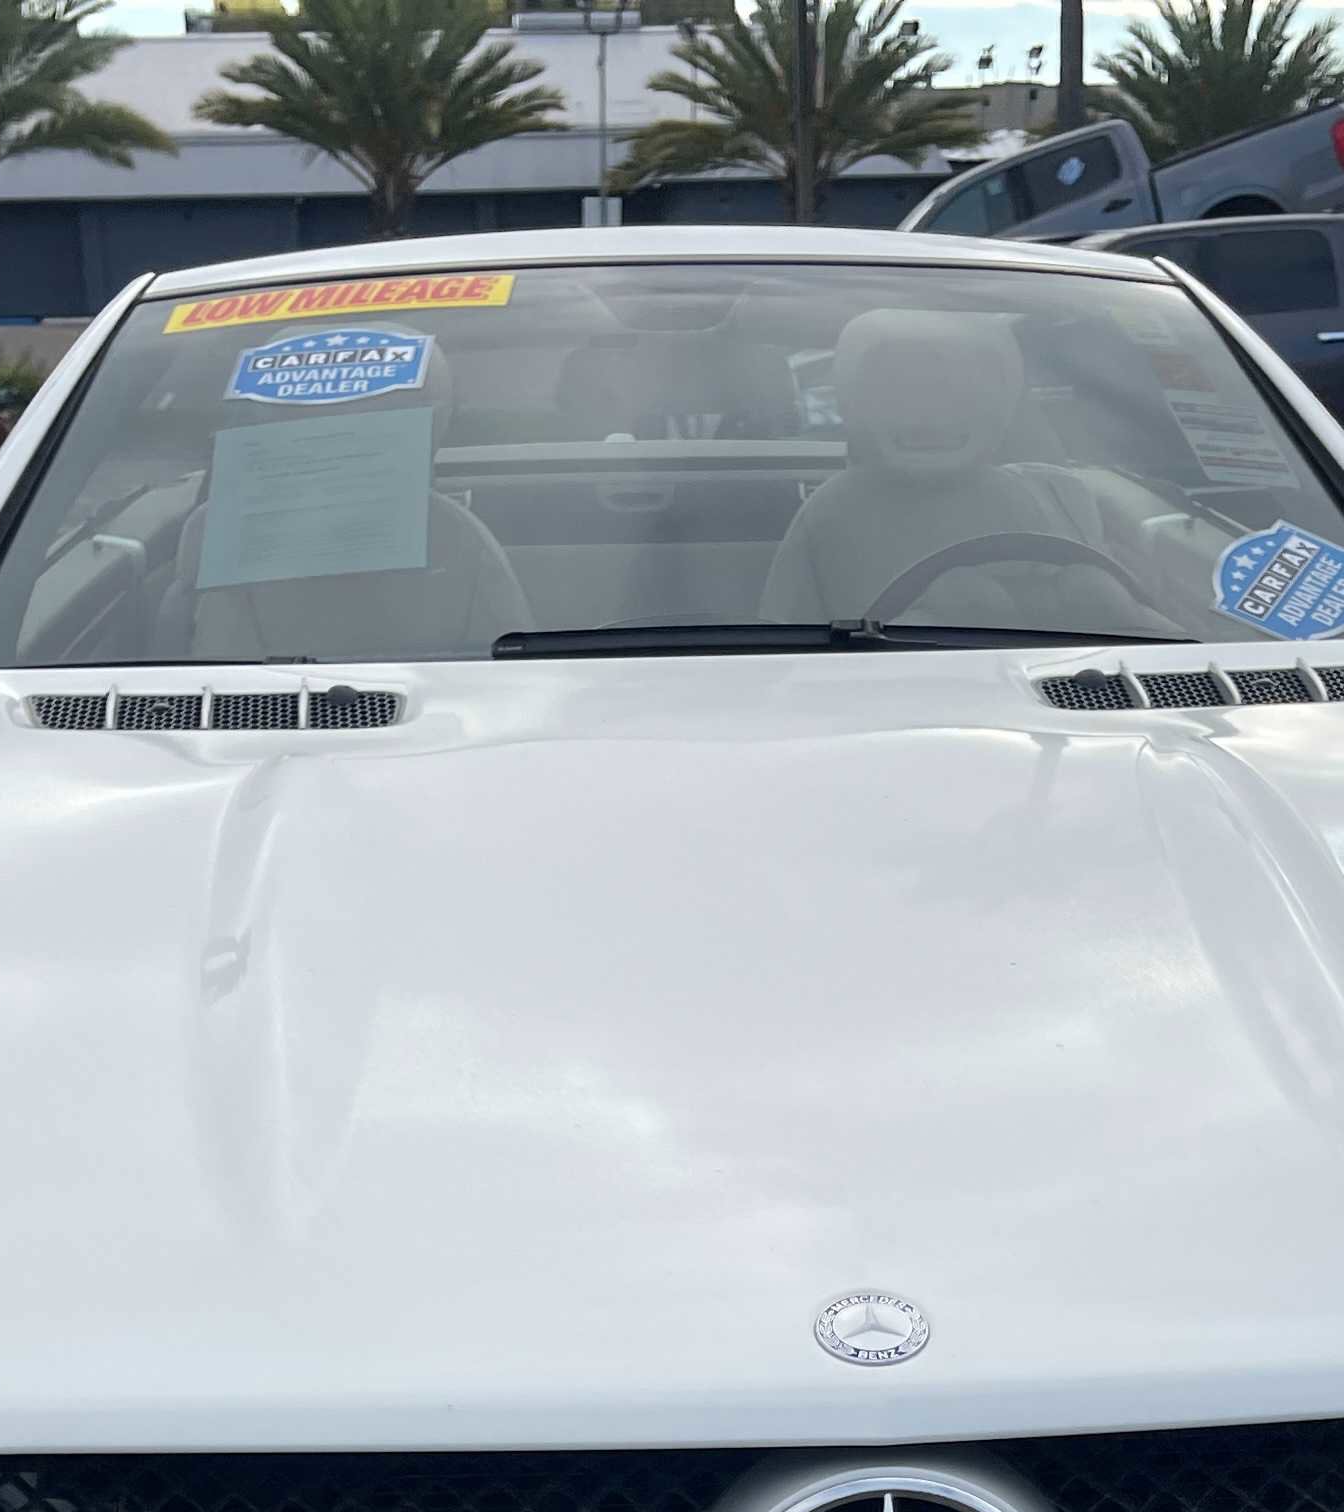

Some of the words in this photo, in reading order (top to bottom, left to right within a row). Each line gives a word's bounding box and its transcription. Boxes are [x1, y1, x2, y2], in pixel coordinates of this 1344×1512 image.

[181, 290, 290, 326] LOW
[287, 276, 495, 313] MILEAGE
[253, 346, 414, 371] CARFAX
[257, 364, 397, 386] ADVANTAGE
[277, 379, 369, 398] DEALER
[1238, 538, 1319, 618] CARFAX
[1277, 553, 1344, 627] ADVANTAGE
